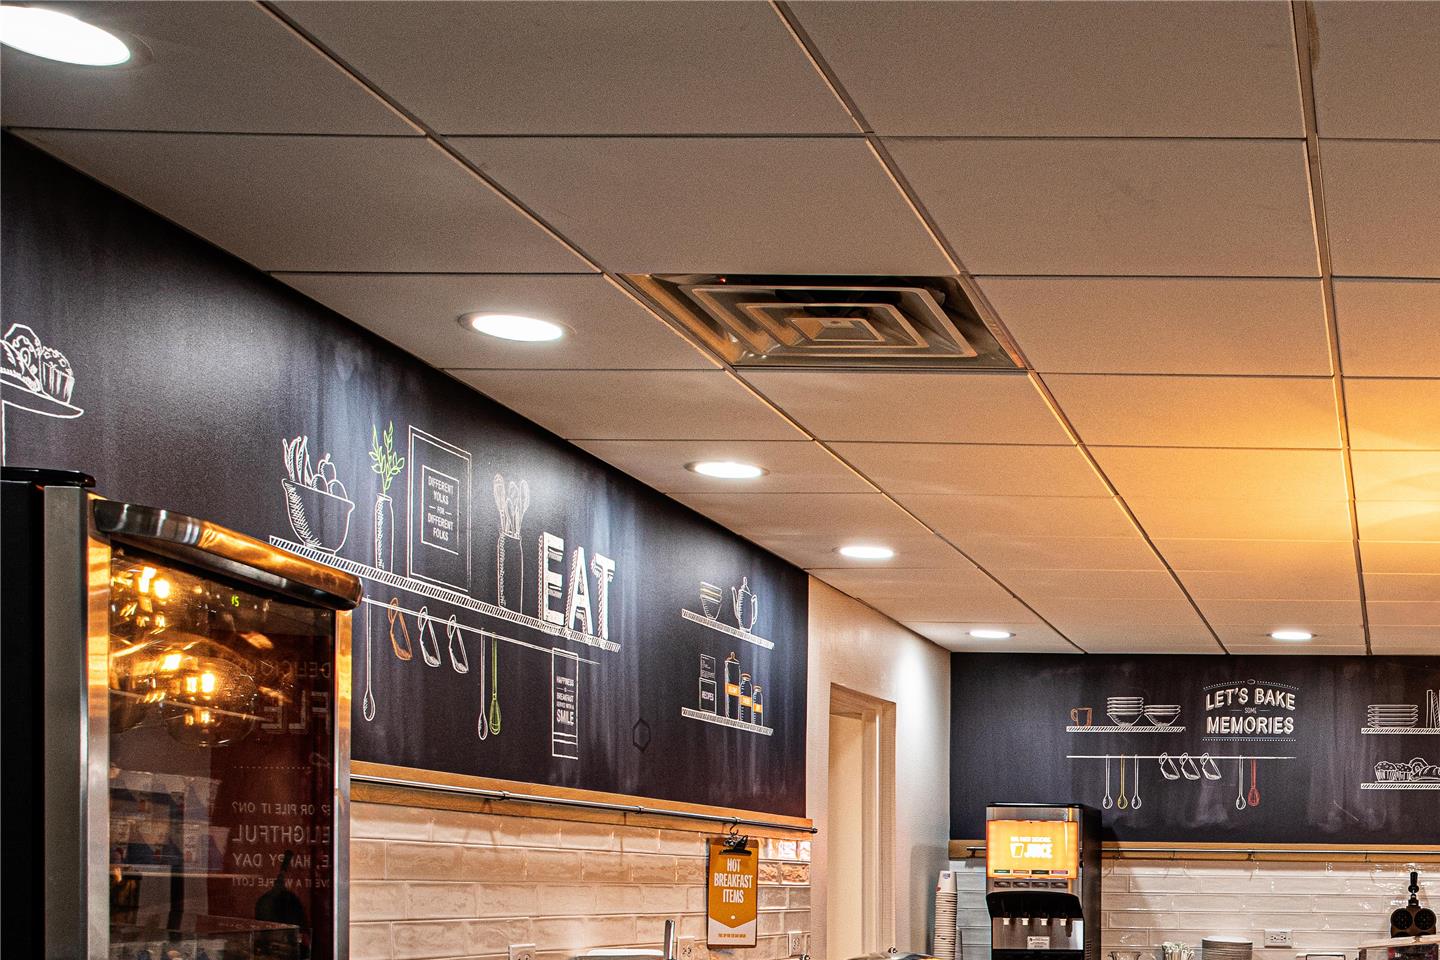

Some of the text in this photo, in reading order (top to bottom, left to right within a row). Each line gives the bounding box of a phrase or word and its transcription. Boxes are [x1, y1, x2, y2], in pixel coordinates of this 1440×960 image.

[428, 476, 454, 495] DIFFERENT
[433, 490, 449, 505] YOLKS
[427, 513, 454, 531] DIFFERENT
[432, 527, 449, 541] FOLKS
[538, 532, 616, 640] EAT
[1205, 687, 1296, 711] LET'S BAKE
[556, 709, 574, 726] SMILE
[1206, 716, 1295, 735] MEMORIES
[726, 858, 742, 873] HOT
[713, 872, 753, 889] BREAKFAST
[722, 889, 744, 904] ITEMS
